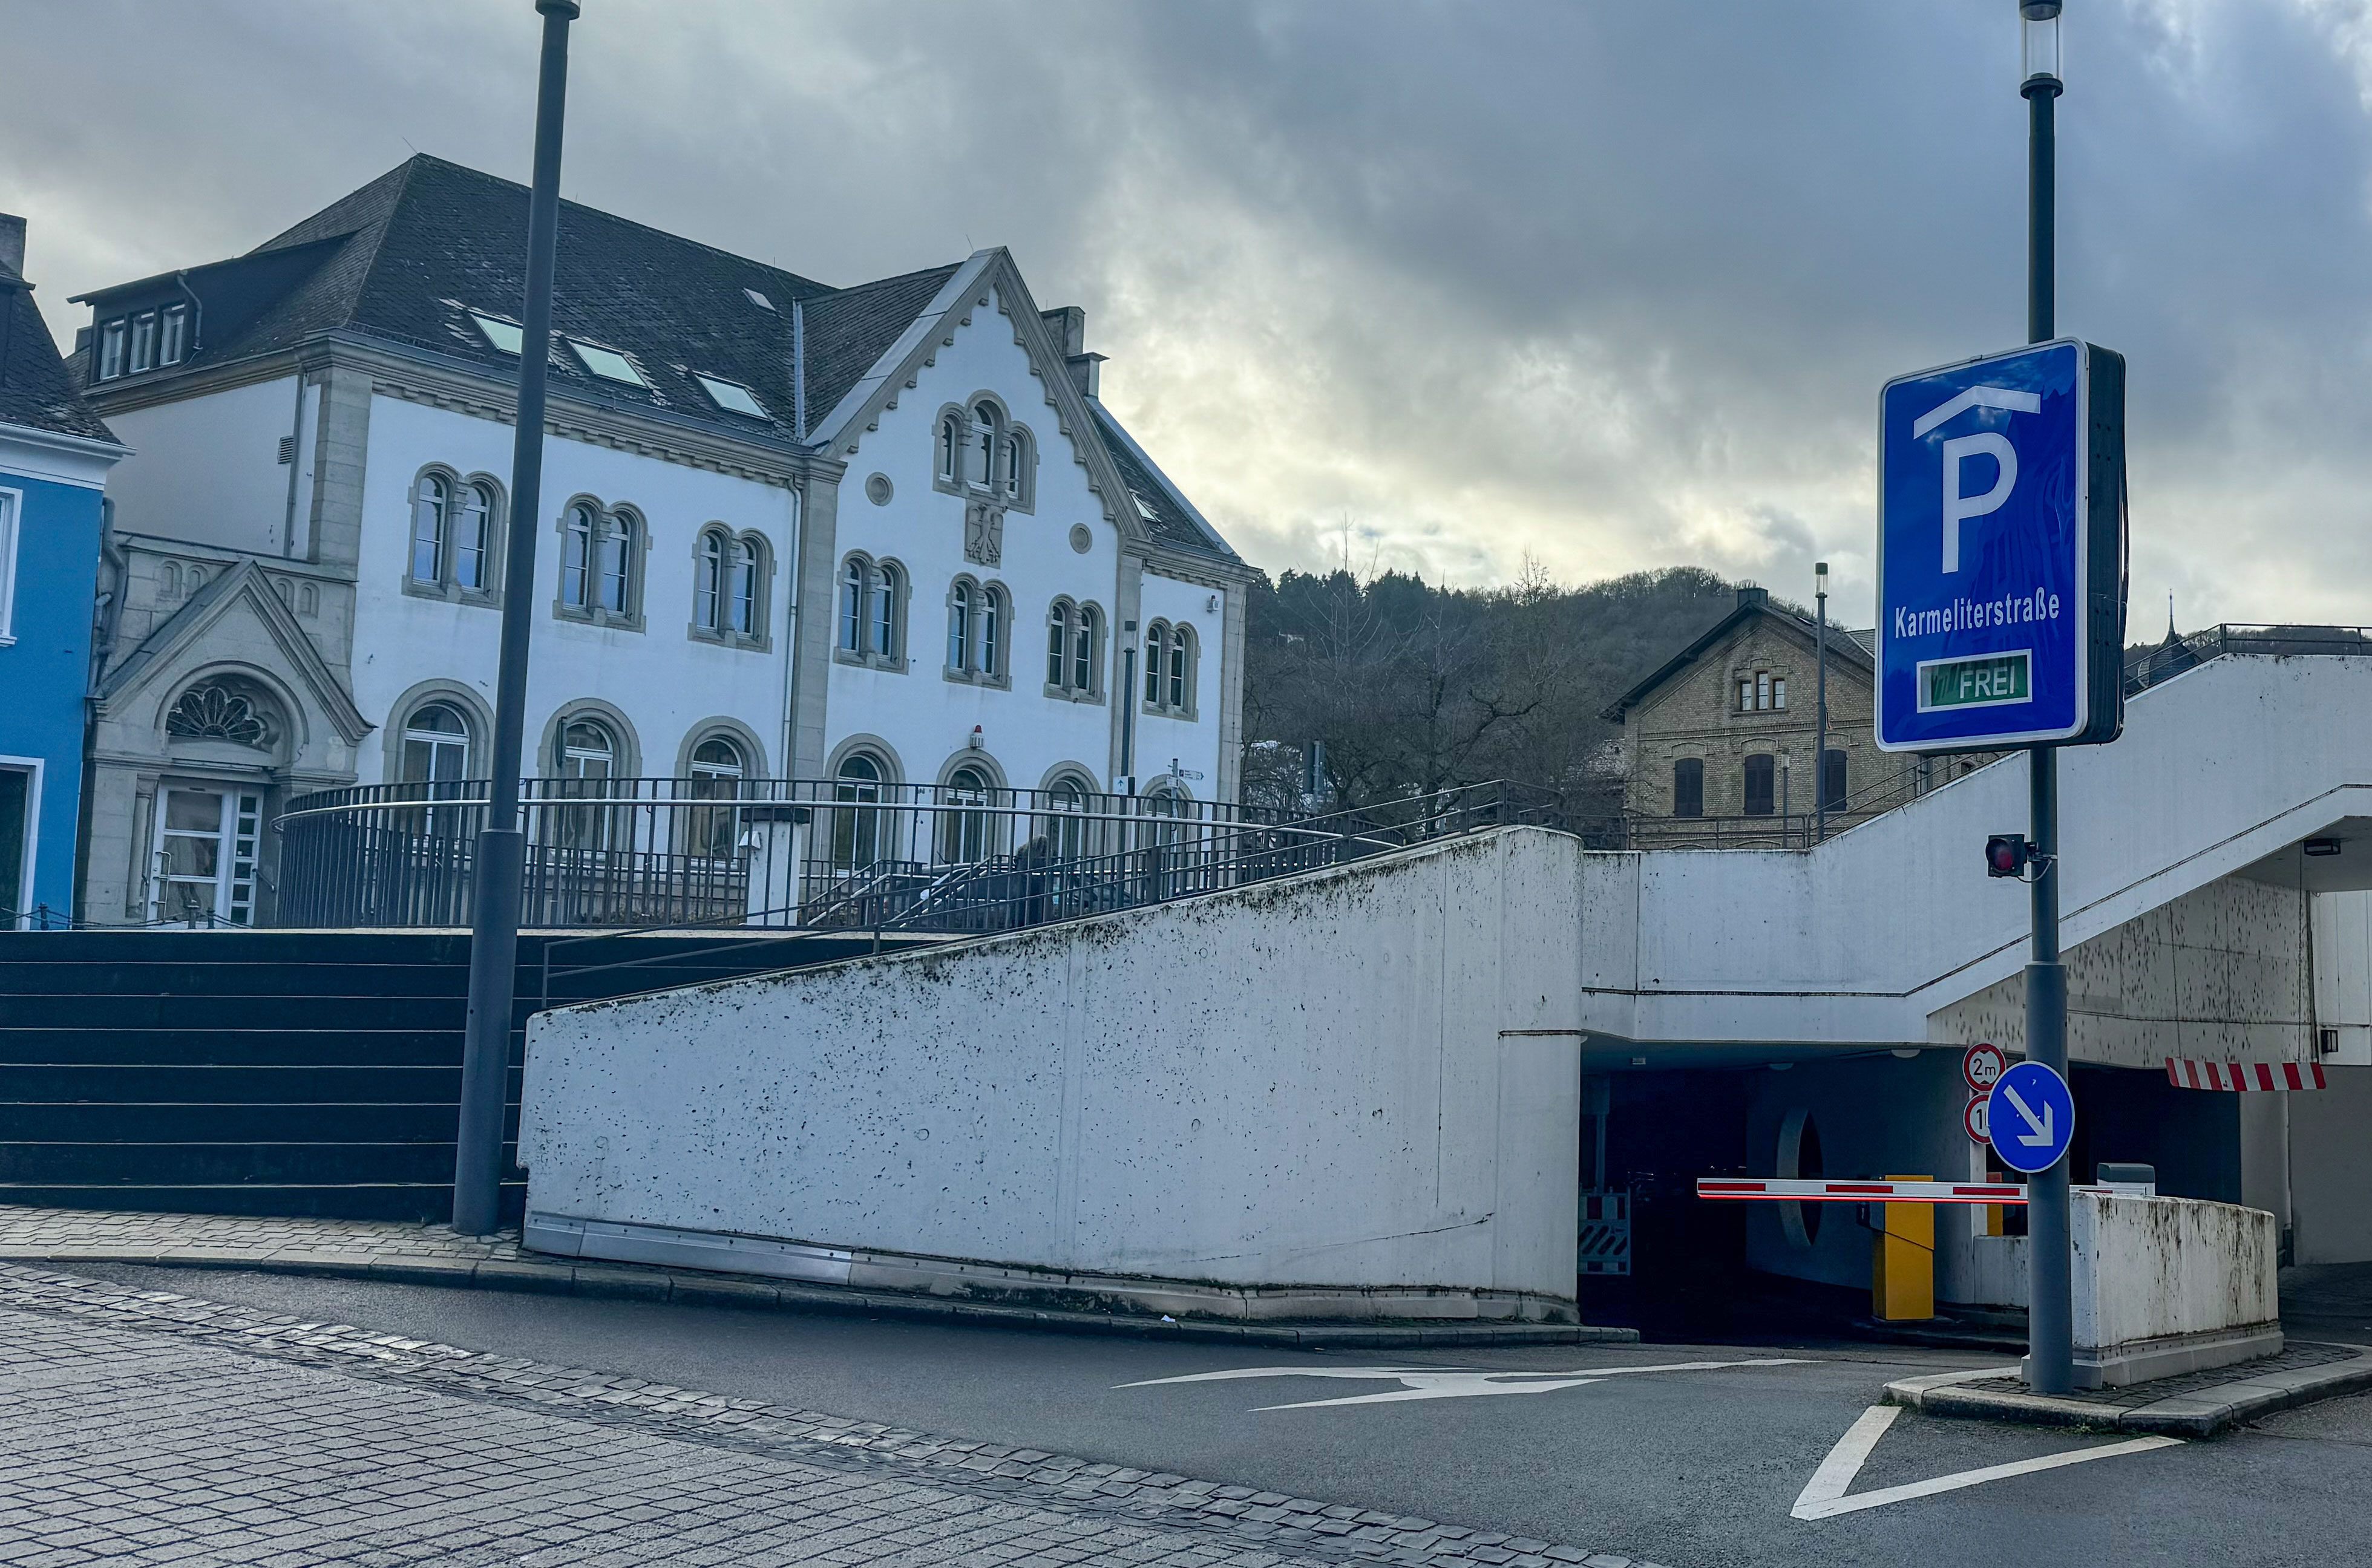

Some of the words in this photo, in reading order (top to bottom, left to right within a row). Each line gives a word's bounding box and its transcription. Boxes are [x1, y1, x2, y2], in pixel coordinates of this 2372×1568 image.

[1942, 433, 2017, 573] P
[1895, 587, 2059, 638] Karmeliterstraße
[1960, 665, 2015, 699] FREI
[1976, 1108, 1987, 1129] 1
